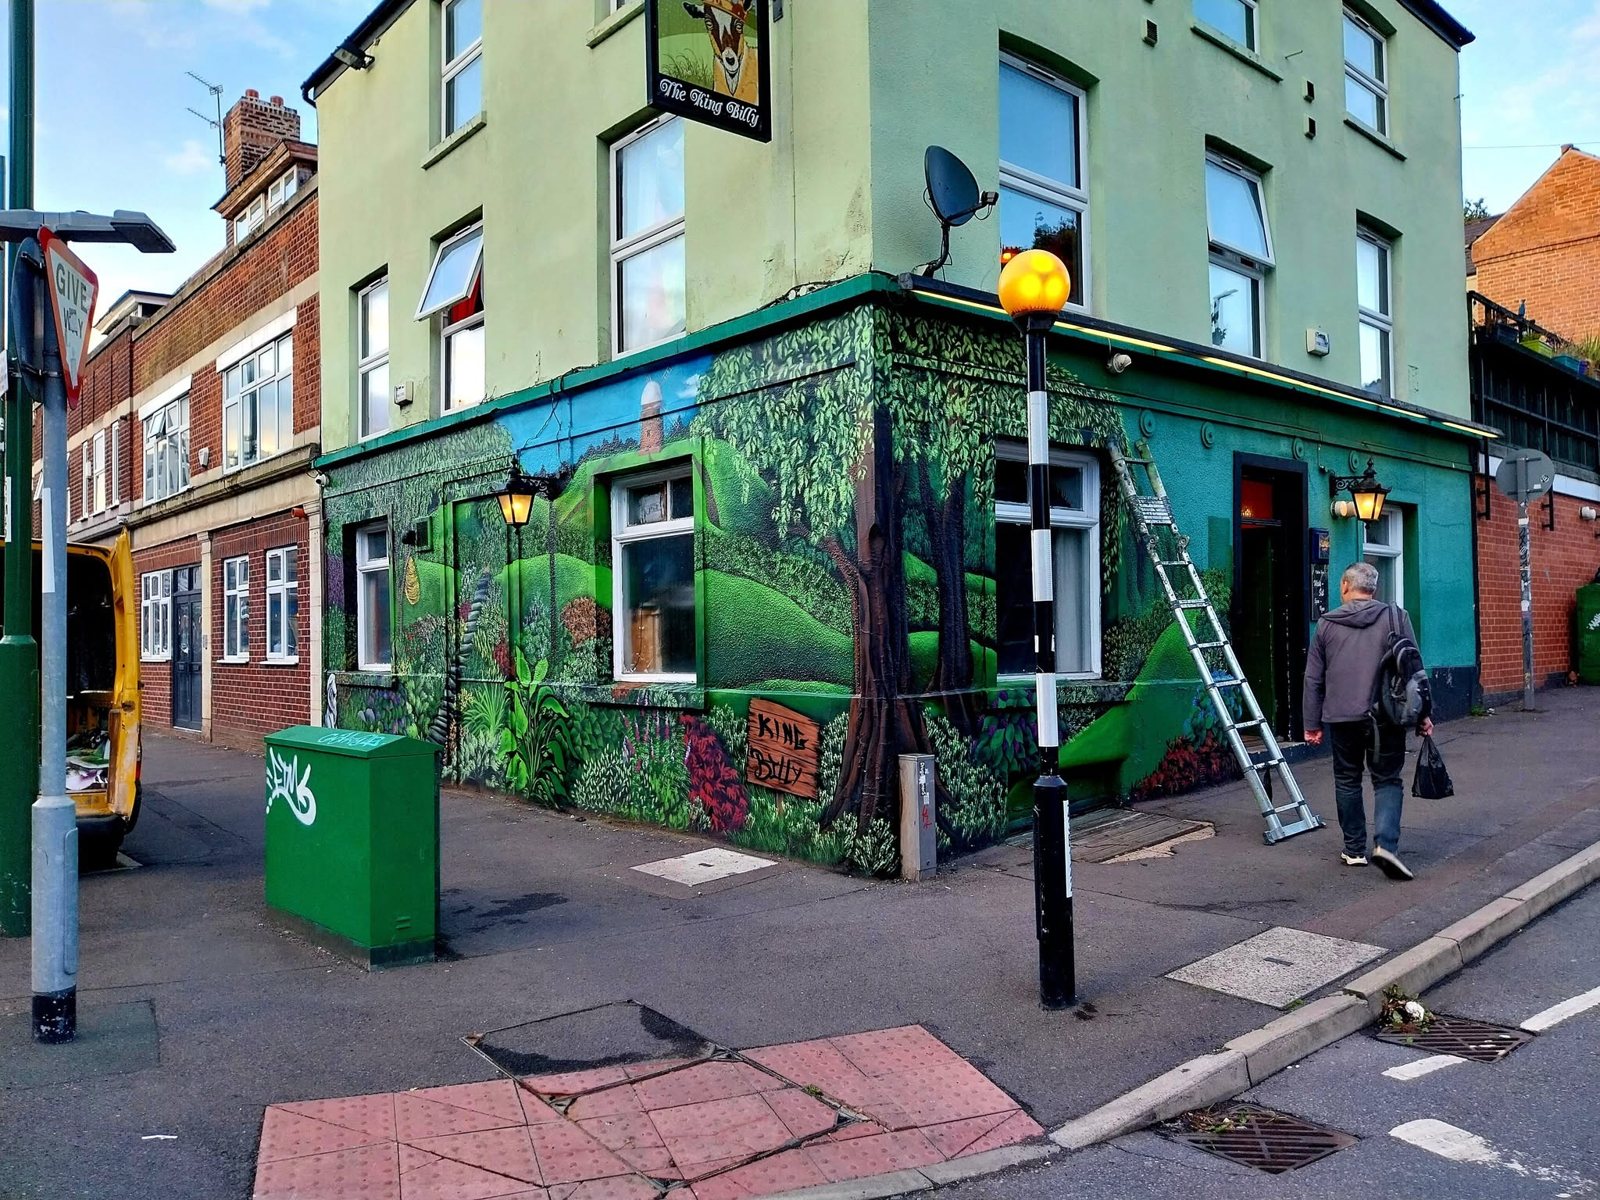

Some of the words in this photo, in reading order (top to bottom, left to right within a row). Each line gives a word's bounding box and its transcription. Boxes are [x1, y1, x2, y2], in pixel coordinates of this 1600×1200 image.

[659, 78, 687, 101] The
[689, 89, 724, 116] King
[725, 101, 760, 128] Billy
[56, 263, 87, 313] GIVE
[63, 307, 83, 338] WY
[757, 713, 809, 750] KING
